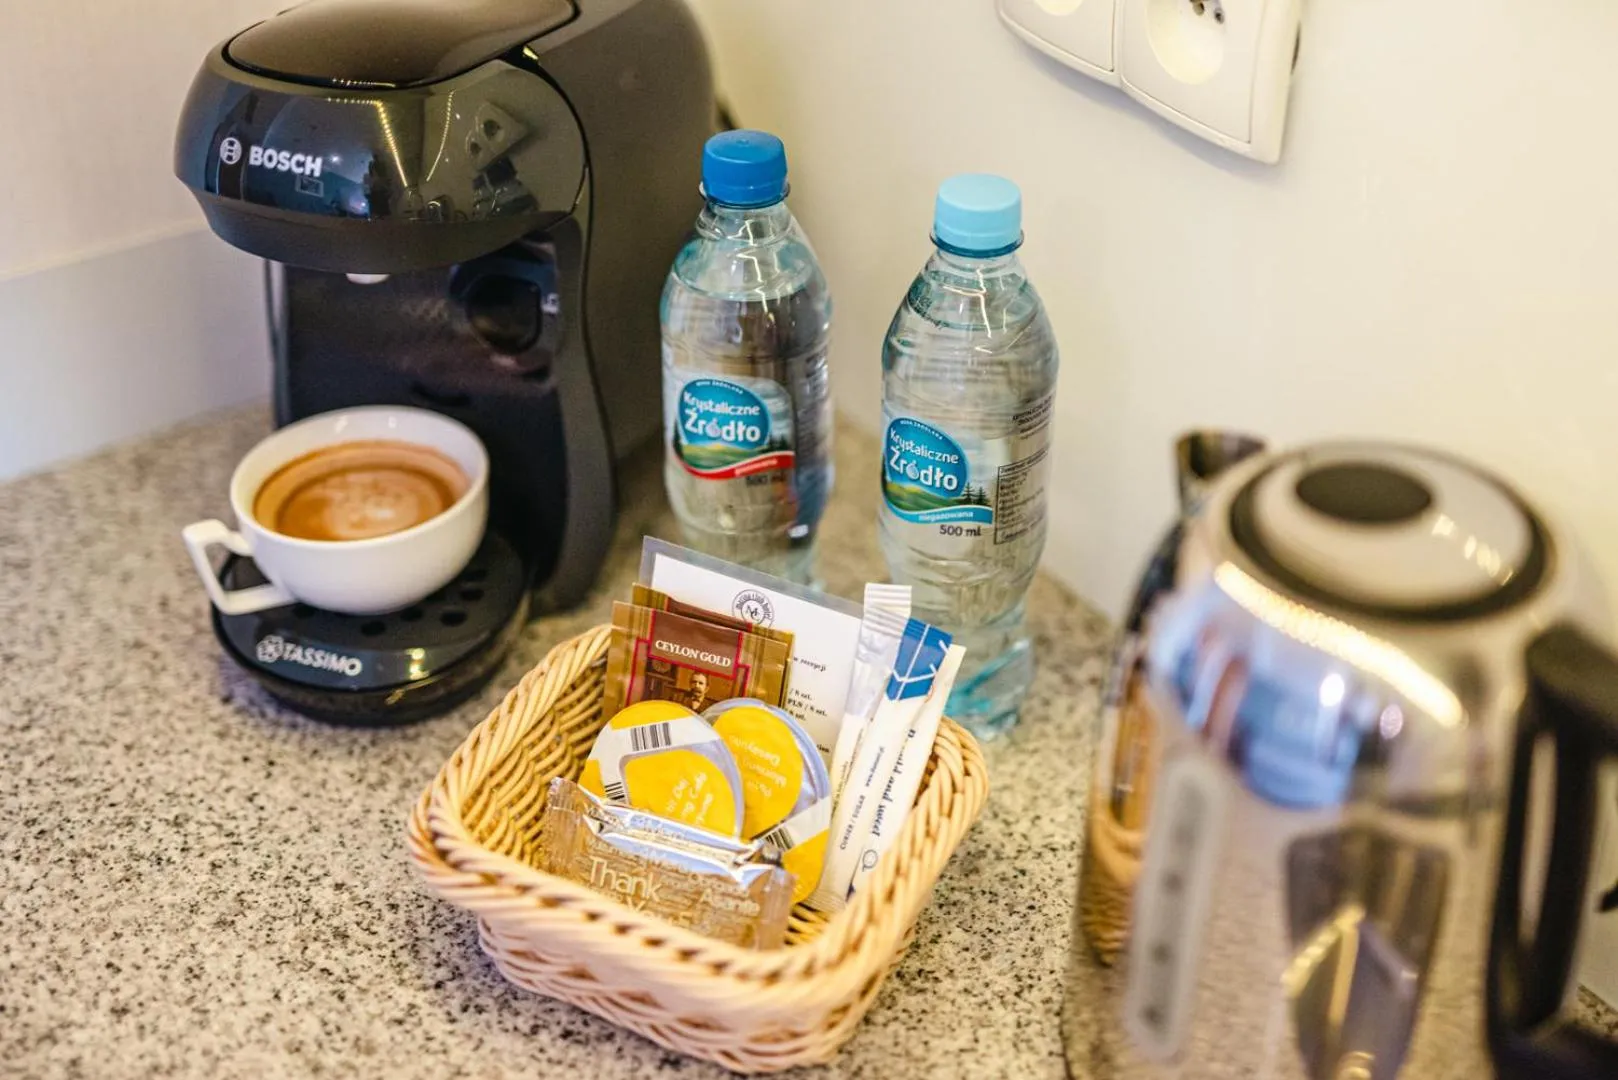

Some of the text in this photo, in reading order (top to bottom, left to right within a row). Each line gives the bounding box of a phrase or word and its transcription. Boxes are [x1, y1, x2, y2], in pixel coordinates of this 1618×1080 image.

[249, 145, 323, 177] BOSCH
[683, 391, 760, 415] Krystaliczne
[685, 407, 761, 442] Źródło
[891, 427, 959, 464] Krystaliczne
[890, 445, 958, 490] Źródło
[940, 524, 982, 537] 500 ml
[282, 641, 362, 676] TASSIMO
[655, 640, 732, 667] CEYLON GOLD
[589, 855, 662, 902] Thank
